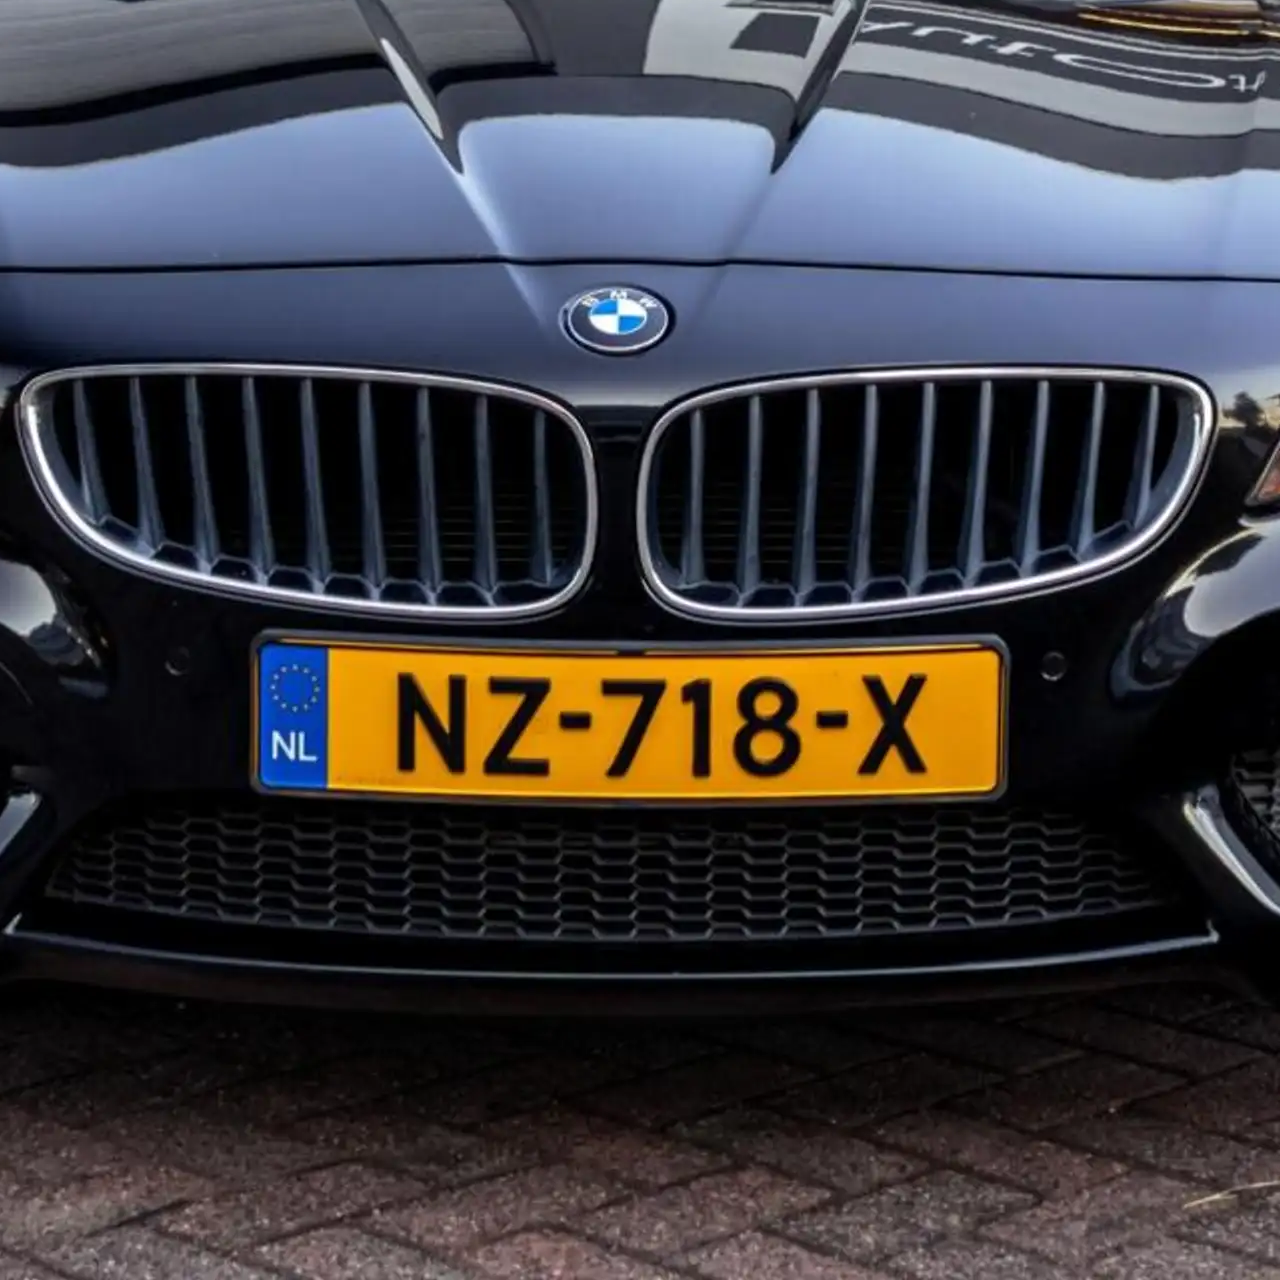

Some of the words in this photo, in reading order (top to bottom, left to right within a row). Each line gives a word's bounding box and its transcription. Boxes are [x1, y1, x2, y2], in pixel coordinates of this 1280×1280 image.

[581, 289, 658, 309] BMW
[397, 672, 928, 779] NZ-718-X
[271, 730, 318, 762] NL
